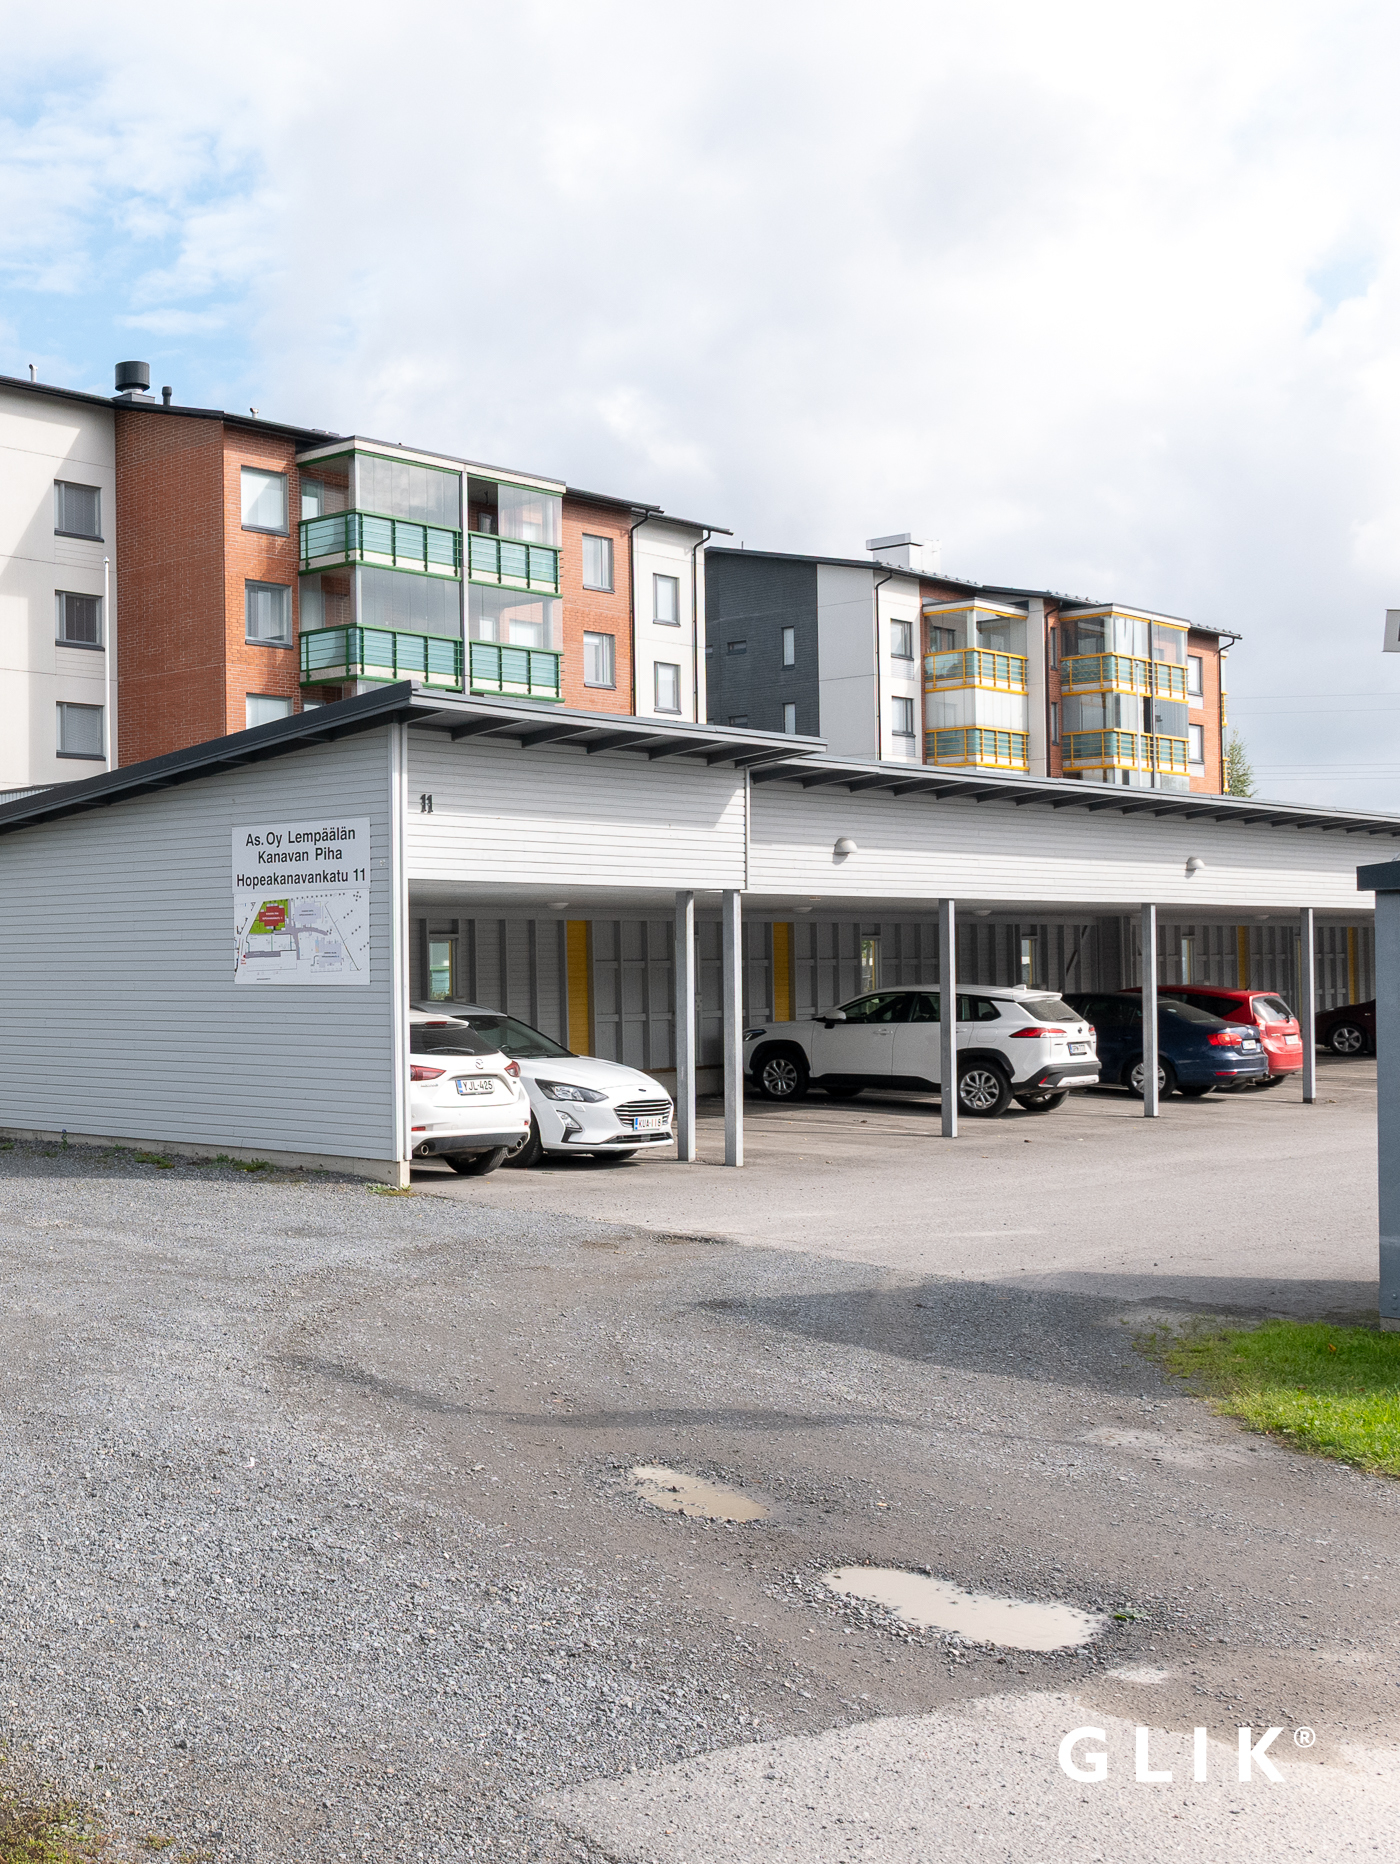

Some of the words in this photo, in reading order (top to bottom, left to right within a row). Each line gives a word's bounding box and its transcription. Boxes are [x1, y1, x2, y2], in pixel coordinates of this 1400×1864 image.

[419, 793, 433, 813] 11
[245, 833, 264, 847] As.
[266, 831, 283, 848] Oy
[288, 826, 356, 845] Lempäälän
[258, 849, 309, 864] Kanavan
[315, 847, 343, 861] Piha
[236, 870, 349, 890] Hopeakanavankatu
[353, 868, 366, 882] 11
[462, 1080, 493, 1092] YJL-425
